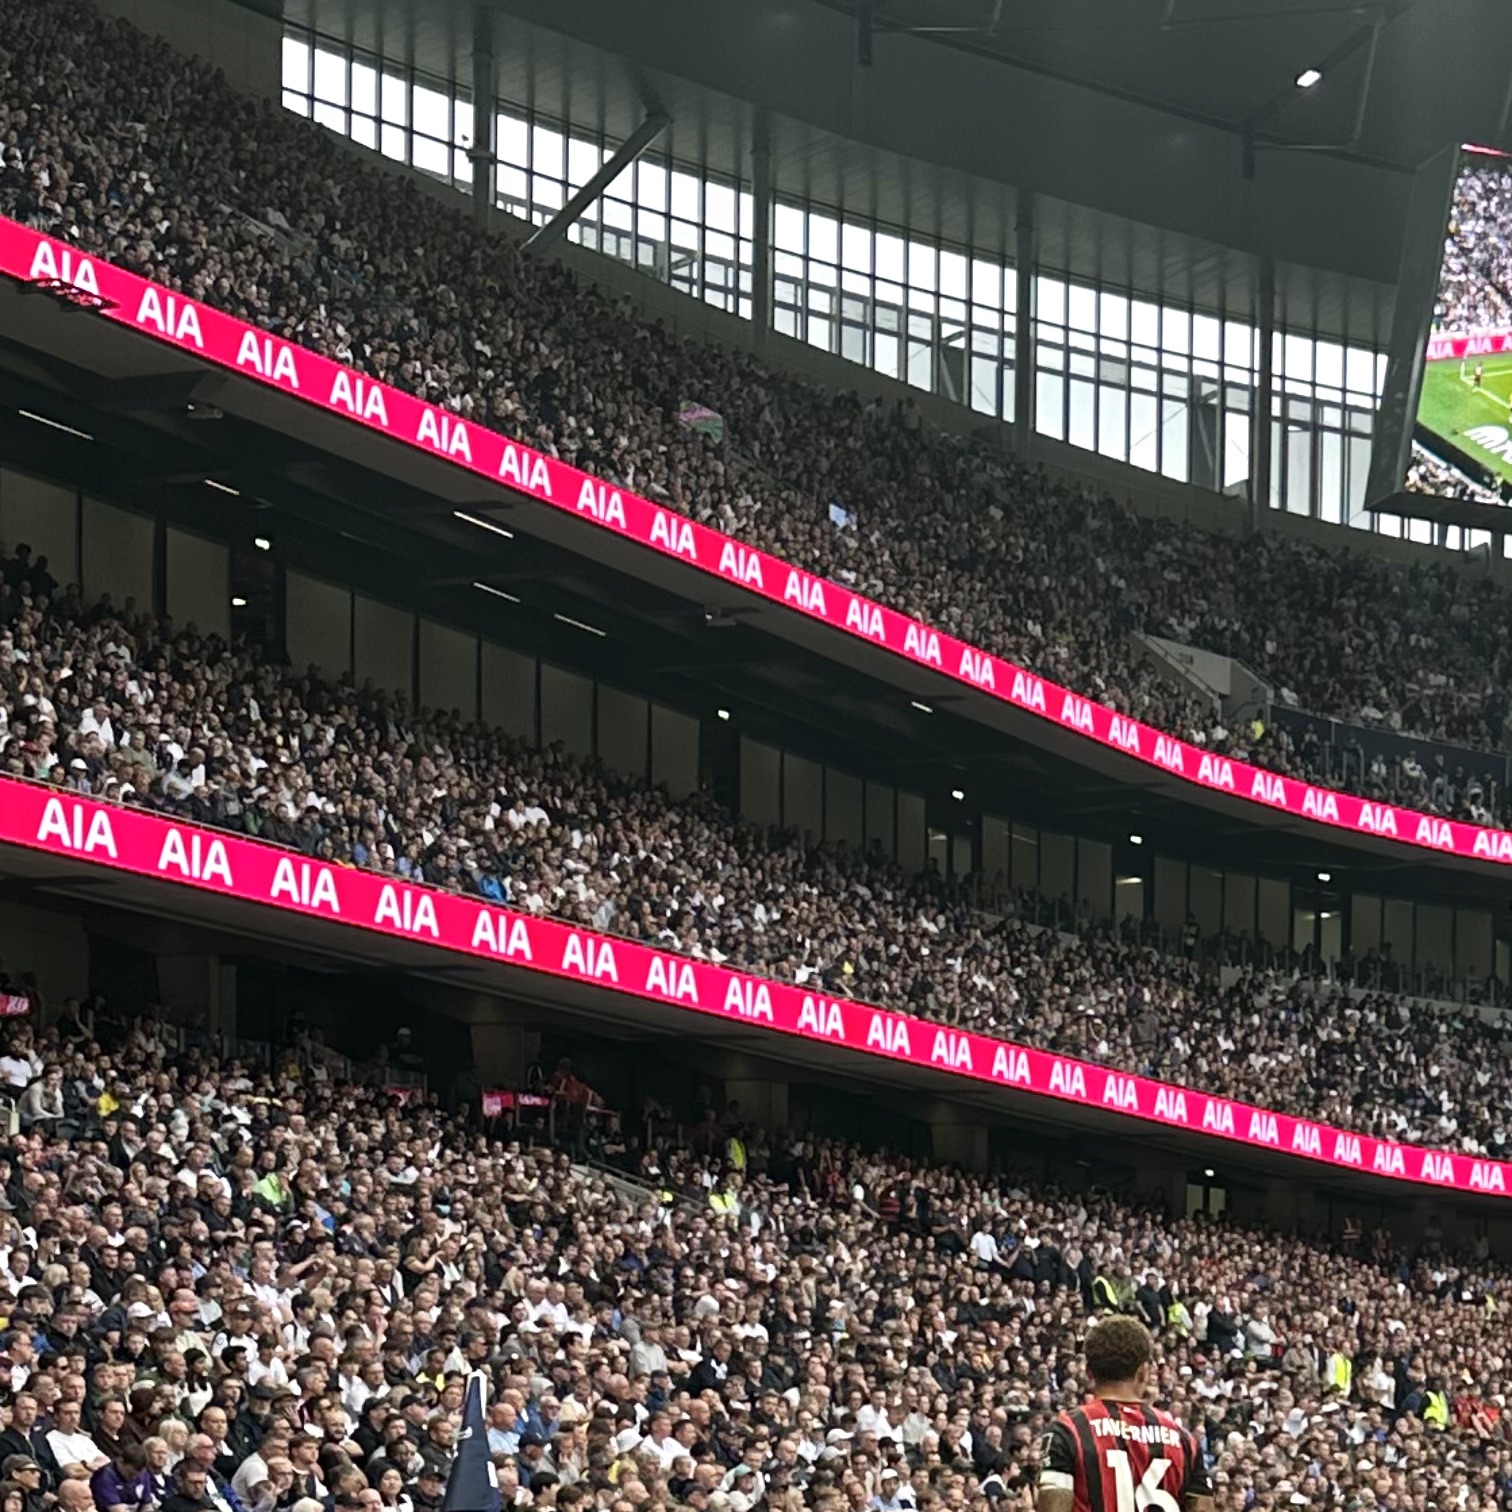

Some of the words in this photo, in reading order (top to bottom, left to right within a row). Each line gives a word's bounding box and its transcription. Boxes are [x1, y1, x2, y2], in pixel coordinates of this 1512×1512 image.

[30, 241, 100, 297] AIA
[136, 286, 203, 348] AIA
[236, 330, 298, 388] AIA
[329, 370, 388, 426] AIA
[416, 408, 472, 462] AIA
[498, 444, 551, 496] AIA
[576, 478, 626, 528] AIA
[649, 511, 696, 559] AIA
[718, 541, 763, 588] AIA
[784, 570, 826, 615] AIA
[845, 597, 885, 640] AIA
[903, 623, 941, 665] AIA
[959, 648, 994, 688] AIA
[1011, 671, 1045, 711] AIA
[1060, 693, 1093, 732] AIA
[1108, 715, 1139, 752] AIA
[1153, 735, 1183, 771] AIA
[1197, 754, 1234, 789] AIA
[1251, 770, 1286, 805] AIA
[1301, 787, 1338, 821] AIA
[1357, 802, 1397, 835] AIA
[1415, 816, 1454, 849] AIA
[36, 797, 117, 858] AIA
[157, 828, 232, 886] AIA
[270, 857, 339, 912] AIA
[374, 884, 439, 937] AIA
[471, 909, 532, 960] AIA
[561, 933, 618, 982] AIA
[645, 955, 698, 1002] AIA
[723, 976, 773, 1021] AIA
[797, 995, 844, 1039] AIA
[866, 1013, 910, 1055] AIA
[931, 1030, 972, 1070] AIA
[991, 1045, 1030, 1084] AIA
[1048, 1060, 1086, 1098] AIA
[1102, 1074, 1138, 1110] AIA
[1153, 1087, 1187, 1122] AIA
[1202, 1099, 1234, 1134] AIA
[1248, 1111, 1278, 1144] AIA
[1291, 1122, 1321, 1155] AIA
[1333, 1133, 1362, 1164] AIA
[1373, 1143, 1405, 1174] AIA
[1420, 1152, 1454, 1183] AIA
[1469, 1161, 1505, 1191] AIA
[1090, 1417, 1181, 1448] TAVERNIER
